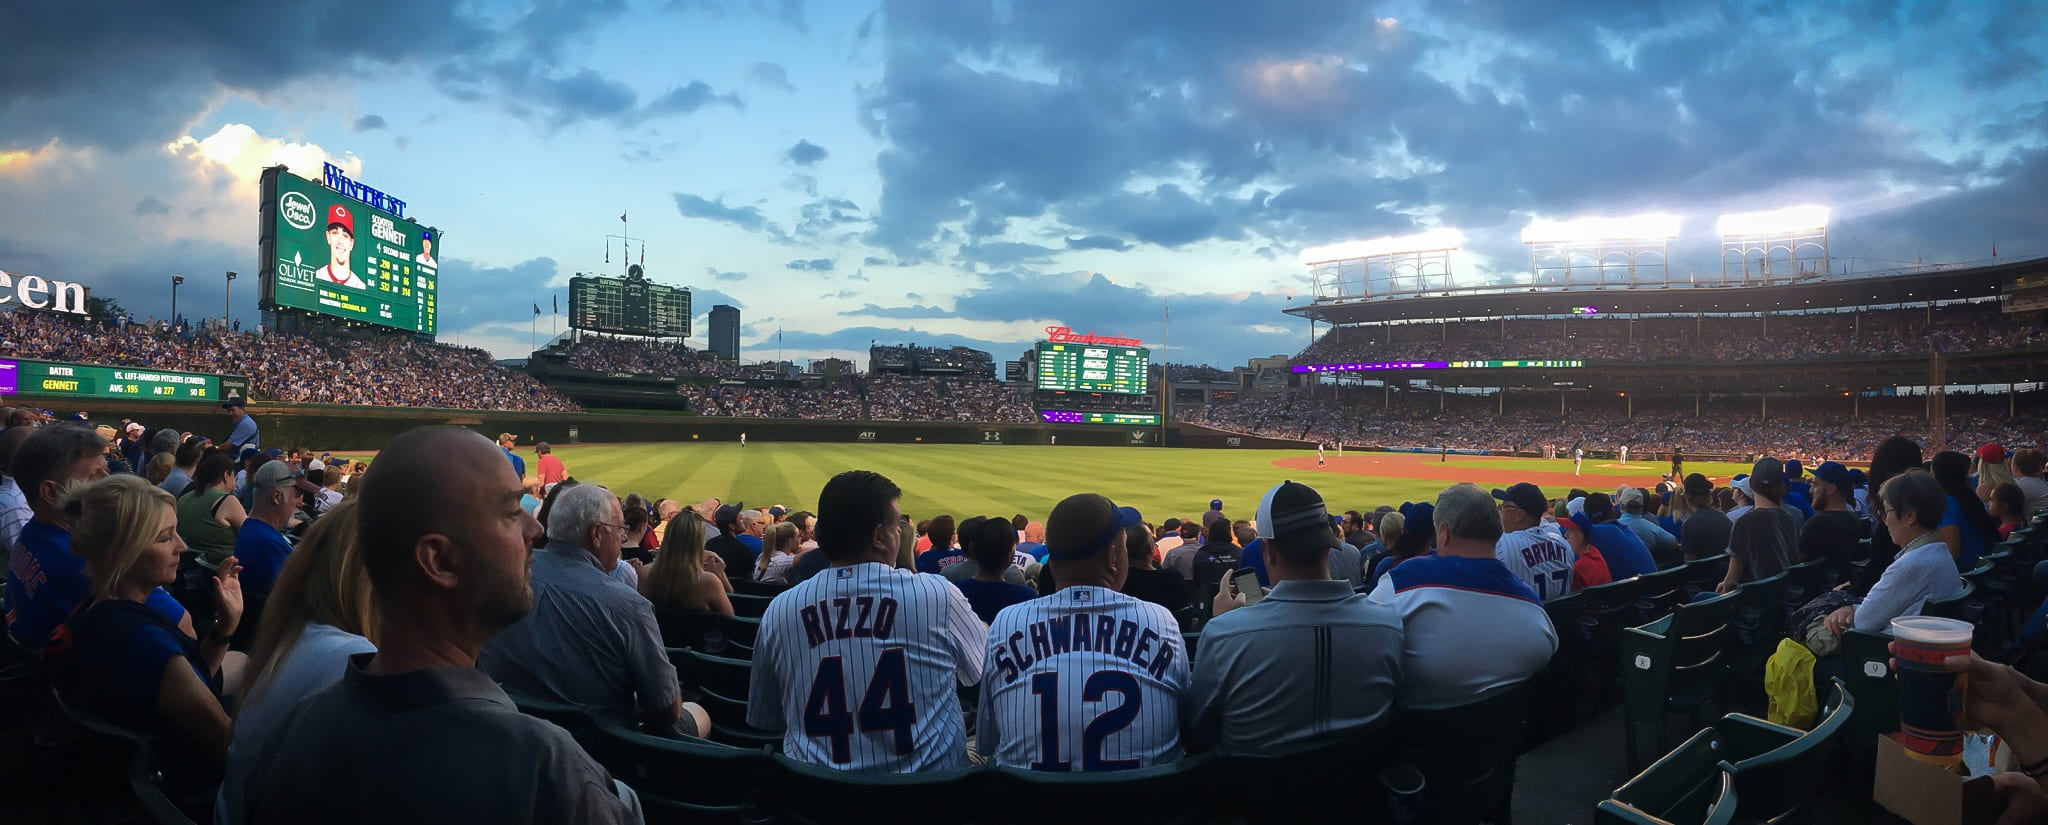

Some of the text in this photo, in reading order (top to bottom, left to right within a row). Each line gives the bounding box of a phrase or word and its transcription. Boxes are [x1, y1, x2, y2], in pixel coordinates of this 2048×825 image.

[323, 161, 406, 218] WINTRUST
[285, 196, 310, 214] Jewel
[371, 222, 407, 247] GENNETT
[278, 263, 315, 283] OLIVET
[1045, 325, 1143, 347] Budweiser
[49, 366, 74, 377] BATTER
[114, 371, 124, 380] VS.
[124, 372, 160, 382] LEFT-HANDED
[160, 375, 184, 384] PITCHERS
[42, 379, 79, 391] GENNETT
[109, 384, 206, 397] AVG .195 AB 277 SO 85
[1520, 541, 1567, 569] BRYANT
[1534, 568, 1570, 600] 17
[800, 596, 899, 649] RIZZO
[995, 613, 1175, 684] SCHWARBER
[1872, 663, 1879, 673] 9
[804, 647, 918, 765] 44
[1031, 669, 1142, 773] 12
